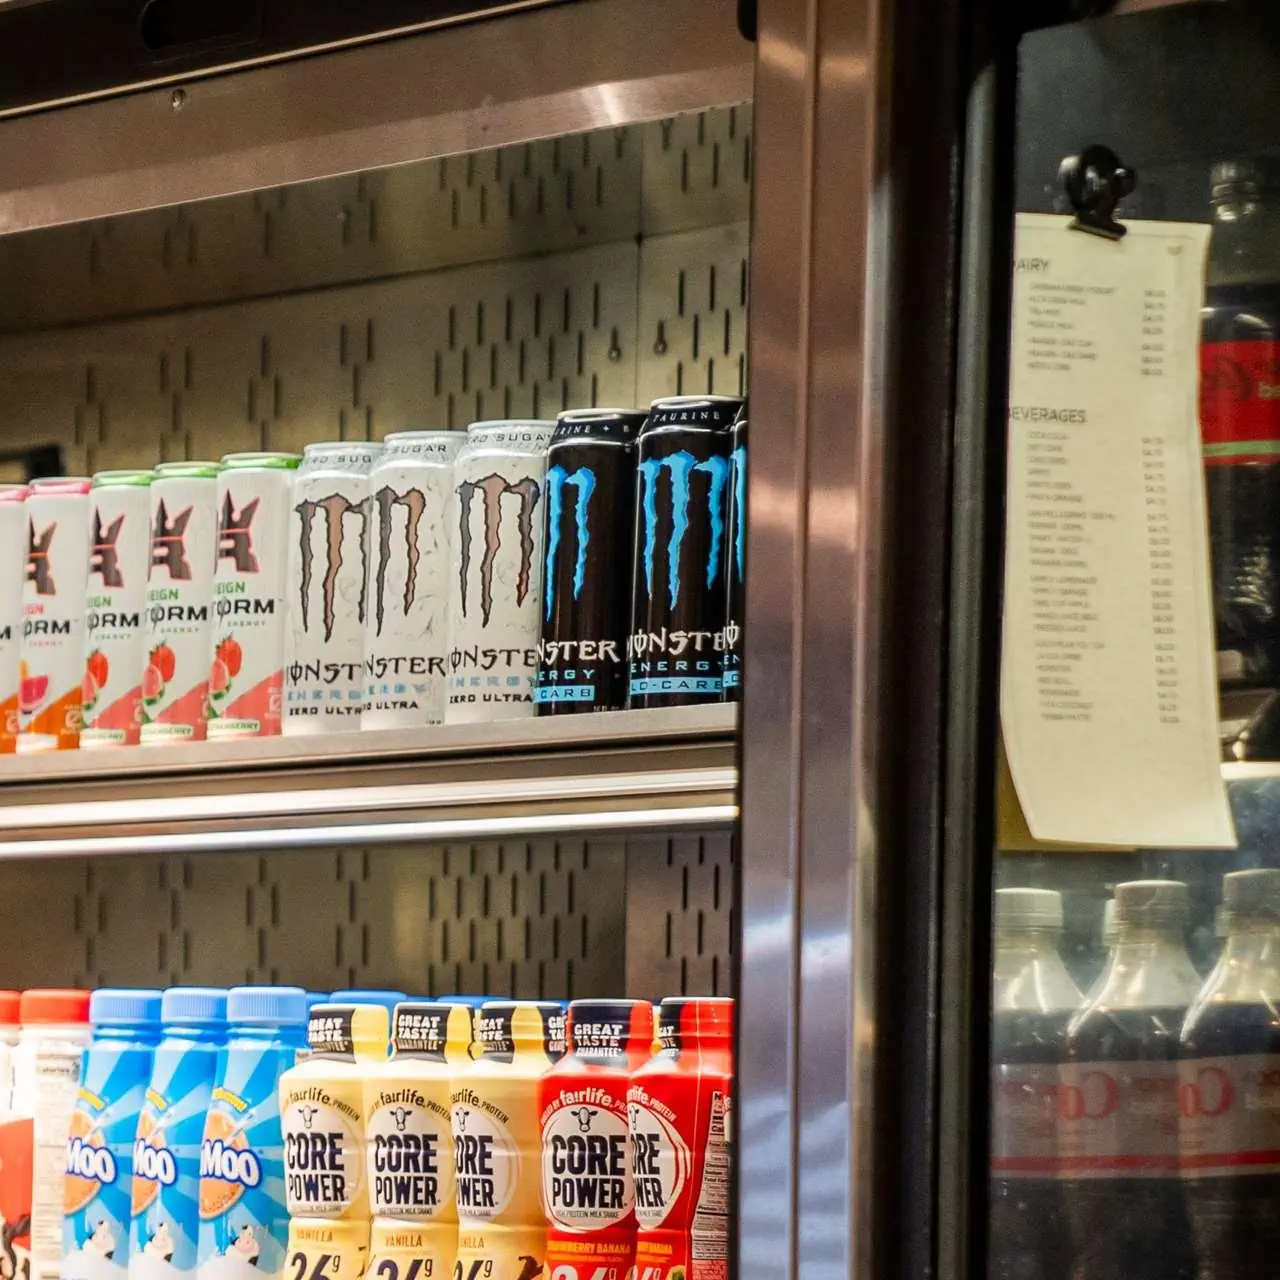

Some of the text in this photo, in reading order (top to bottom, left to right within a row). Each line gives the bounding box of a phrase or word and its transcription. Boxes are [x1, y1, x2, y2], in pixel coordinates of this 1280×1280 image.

[653, 411, 721, 423] TAURINE
[559, 423, 591, 435] RINE
[337, 454, 372, 464] SUG
[391, 443, 448, 455] SUGAR
[148, 588, 179, 601] EIGN
[215, 581, 246, 595] EIGN
[146, 604, 208, 626] ORM
[213, 597, 275, 618] ORM
[23, 619, 71, 638] ORM
[87, 611, 140, 631] ORM
[536, 637, 620, 666] NSTER
[627, 626, 726, 662] ONSTE
[366, 653, 446, 678] NSTER
[449, 644, 537, 673] ONSTE
[287, 658, 362, 686] ONST
[537, 669, 595, 681] ERGY
[288, 689, 362, 701] ENERG
[368, 683, 427, 696] ERGY
[449, 692, 534, 705] ZERO ULTRA
[540, 688, 592, 700] CARB
[289, 706, 318, 716] ZERO
[325, 704, 362, 716] ULTR
[376, 700, 419, 711] ULTRA
[398, 1014, 441, 1028] GREAT
[478, 1017, 505, 1031] REAT
[573, 1023, 623, 1037] GREAT
[397, 1028, 441, 1040] TASTE
[573, 1034, 620, 1048] TASTE
[482, 1100, 509, 1123] PROTEIN
[649, 1095, 676, 1123] PROTEIN
[66, 1137, 118, 1185] Moo
[134, 1138, 177, 1185] Moo
[287, 1132, 345, 1172] CORE
[374, 1133, 439, 1174] CORE
[454, 1134, 494, 1177] ORE
[551, 1134, 628, 1177] CORE
[630, 1133, 660, 1175] ORE
[199, 1139, 261, 1189] Moo
[289, 1173, 347, 1202] POWER
[375, 1175, 439, 1206] POWER
[457, 1177, 495, 1208] WER
[552, 1177, 626, 1209] POWER
[636, 1177, 665, 1208] WER
[296, 1228, 334, 1242] VANILLA
[384, 1235, 423, 1248] VANILLA
[596, 1242, 631, 1254] BANANA
